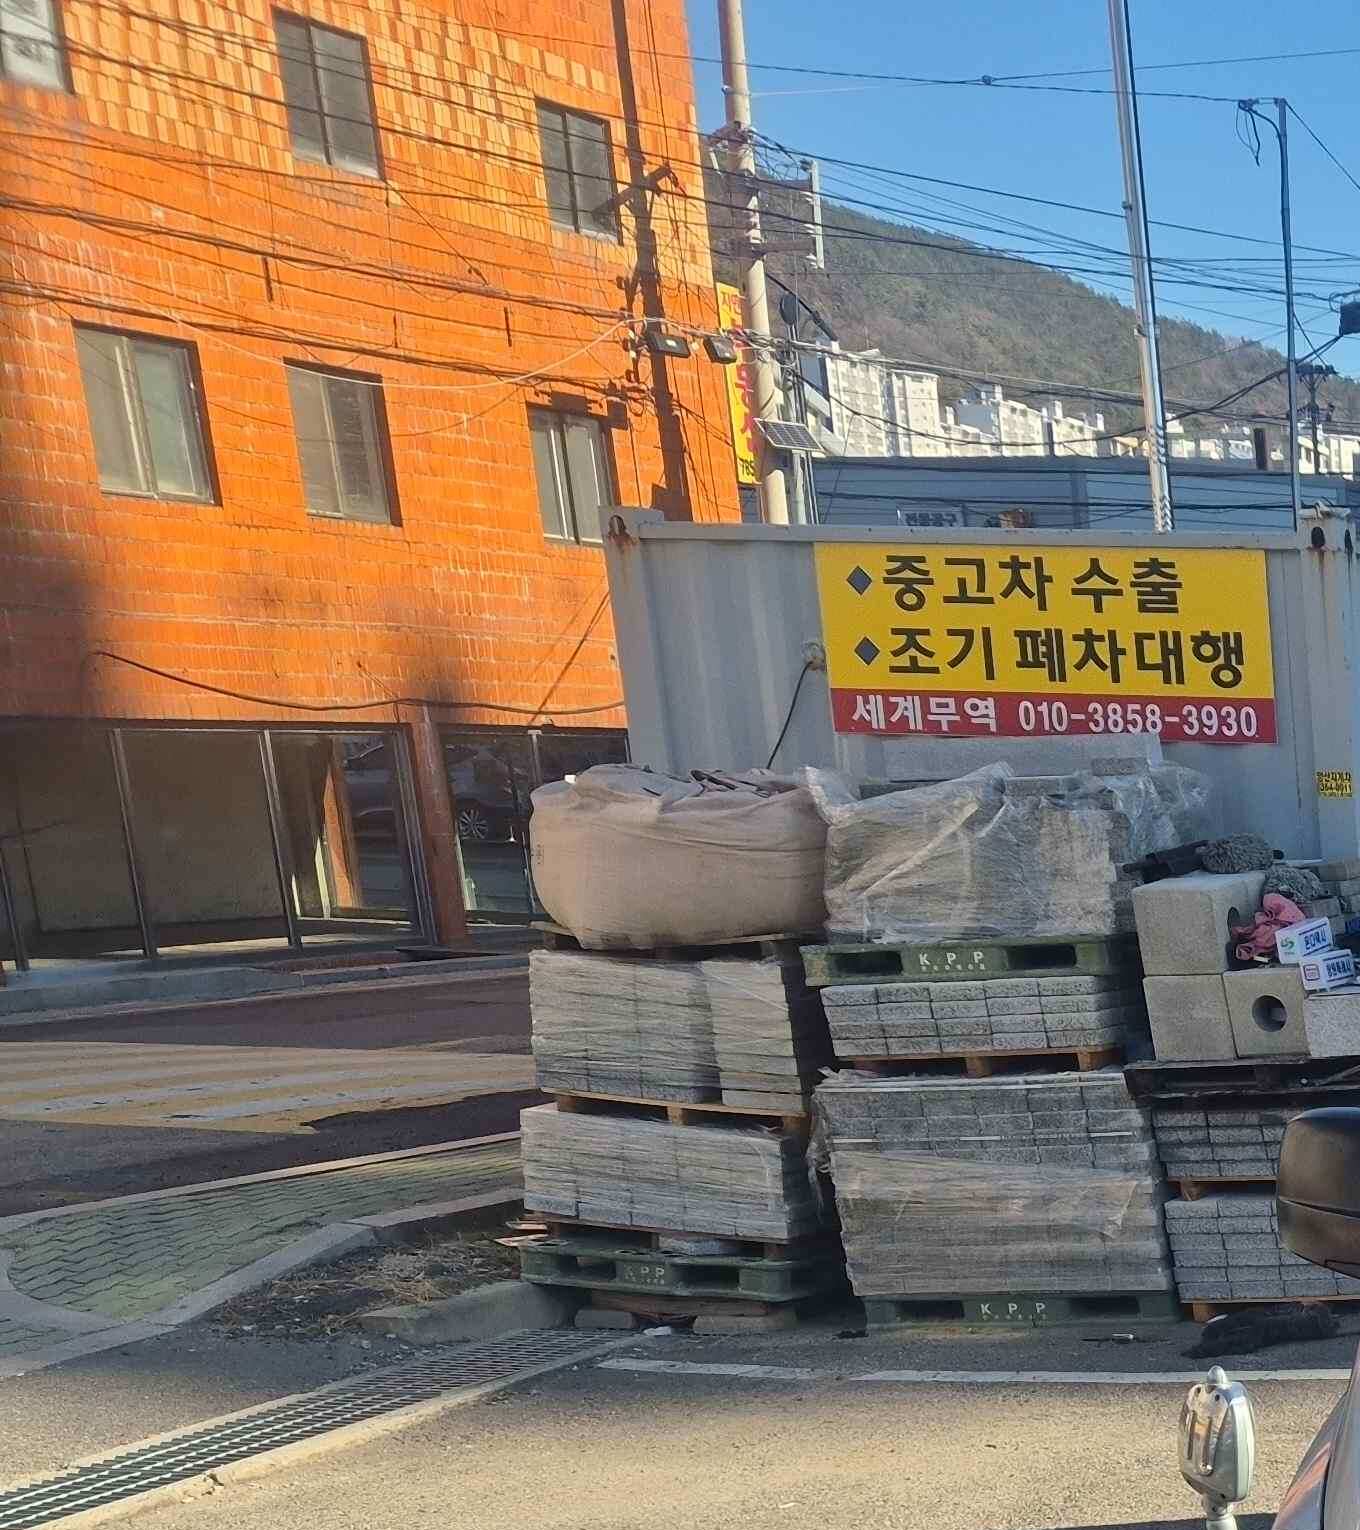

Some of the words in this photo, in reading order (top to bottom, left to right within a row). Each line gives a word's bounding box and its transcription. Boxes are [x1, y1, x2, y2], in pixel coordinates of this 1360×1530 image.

[883, 554, 1054, 611] 중고차
[1071, 557, 1183, 614] 수출
[888, 627, 995, 681] 조기
[1013, 627, 1246, 689] 폐차대행
[852, 694, 997, 732] 세계무역
[1018, 700, 1258, 738] 010-3858-3930
